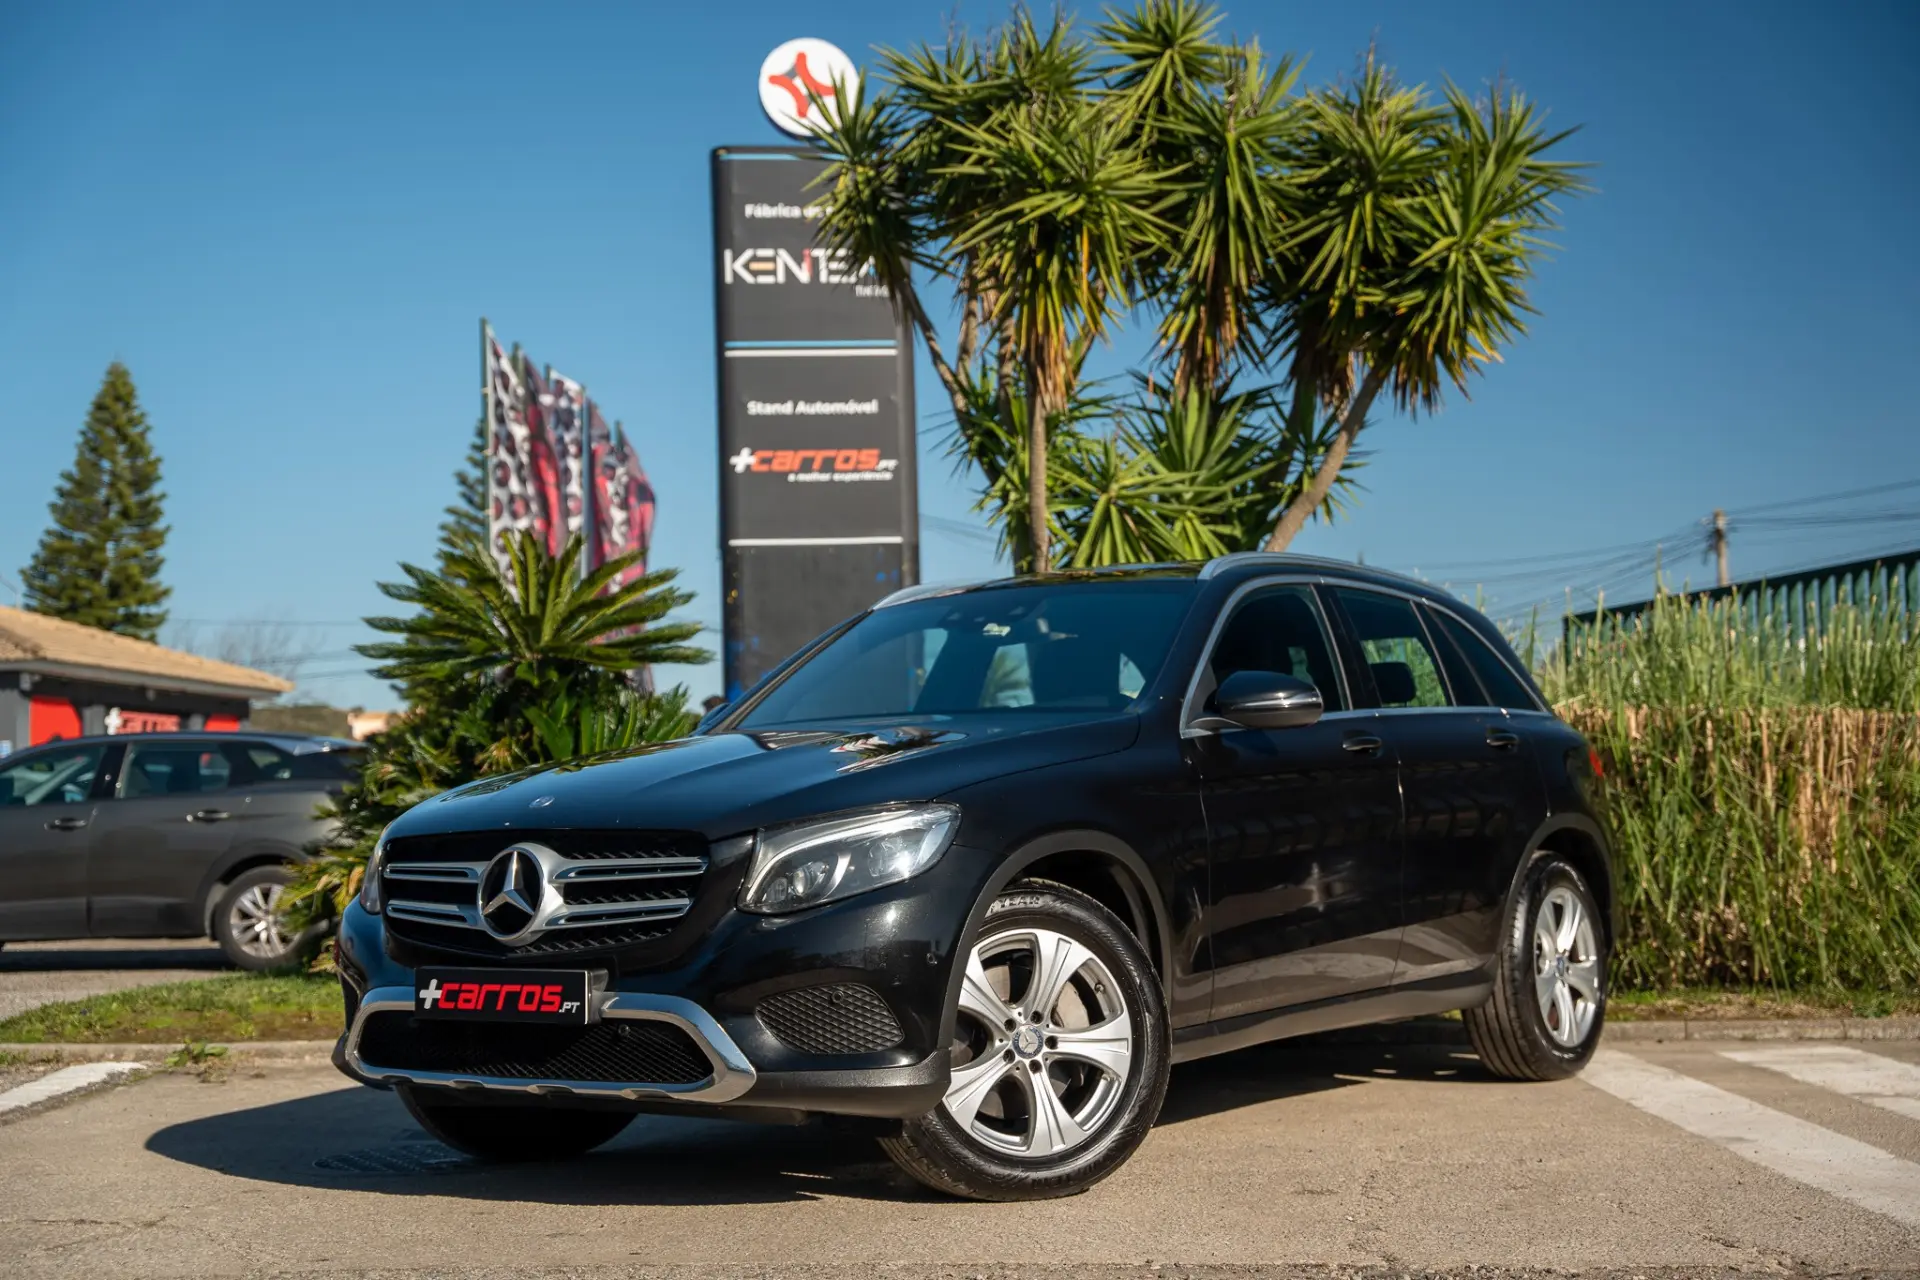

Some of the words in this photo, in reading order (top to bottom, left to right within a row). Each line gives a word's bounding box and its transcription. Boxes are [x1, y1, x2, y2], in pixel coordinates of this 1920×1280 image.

[744, 202, 802, 218] Fábrica
[747, 400, 794, 415] Stand
[795, 399, 879, 415] Automóvel
